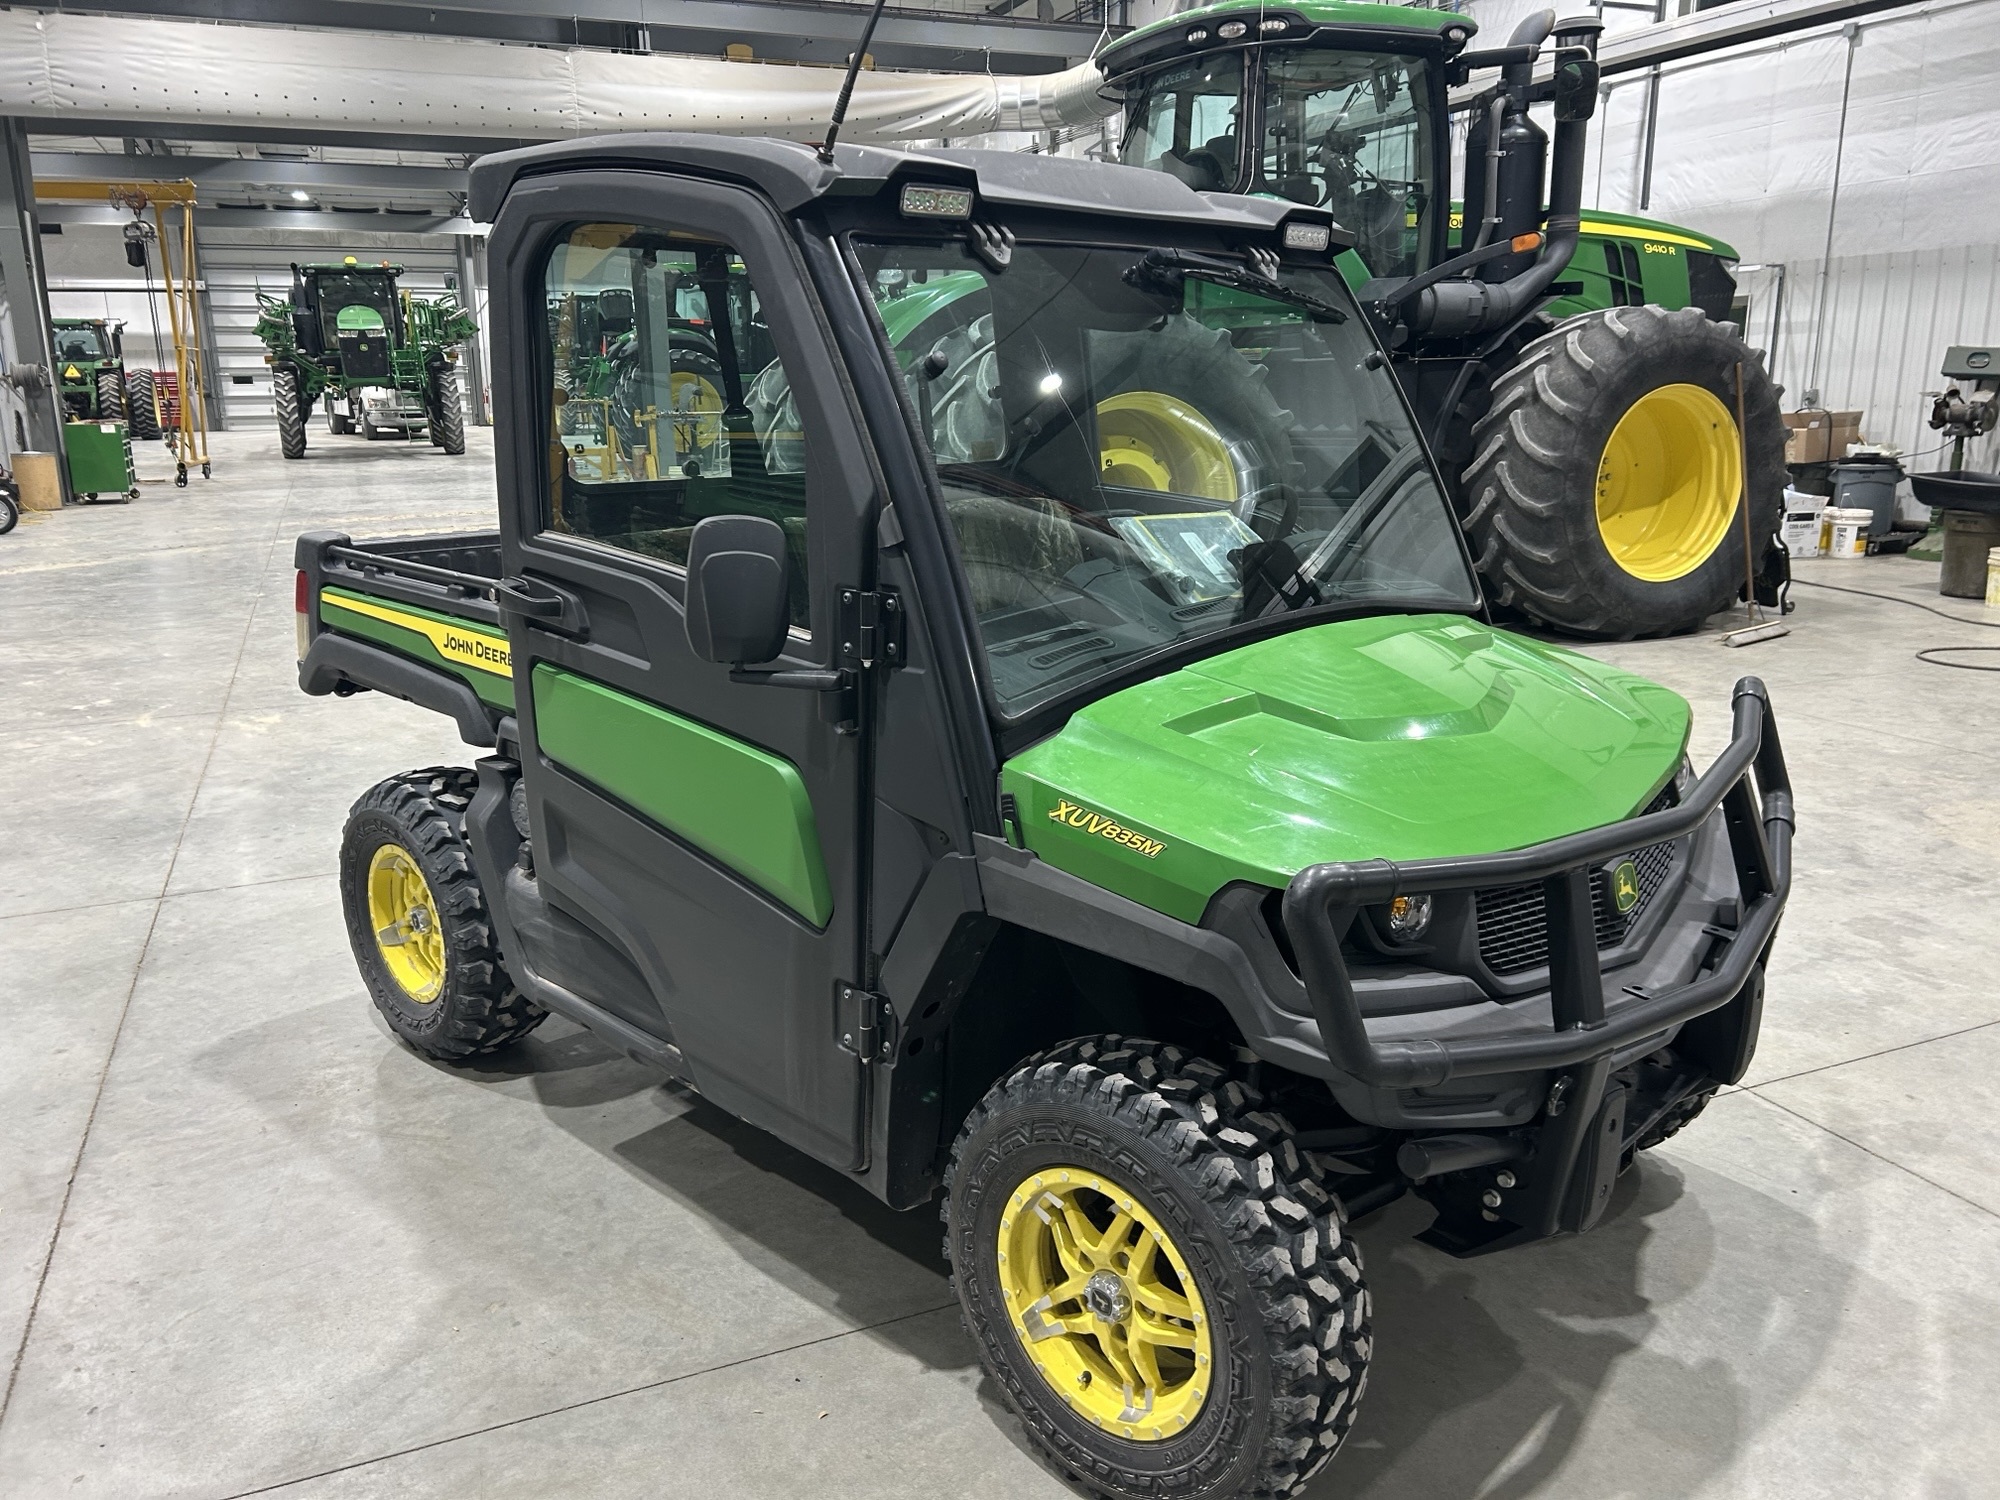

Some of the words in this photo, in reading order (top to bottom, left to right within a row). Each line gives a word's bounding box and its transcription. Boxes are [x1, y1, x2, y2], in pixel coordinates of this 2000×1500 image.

[1164, 69, 1191, 86] DEERE
[1643, 242, 1667, 255] 9410
[1668, 246, 1676, 256] R
[443, 632, 474, 656] JOHN
[1048, 800, 1165, 858] XUV835M
